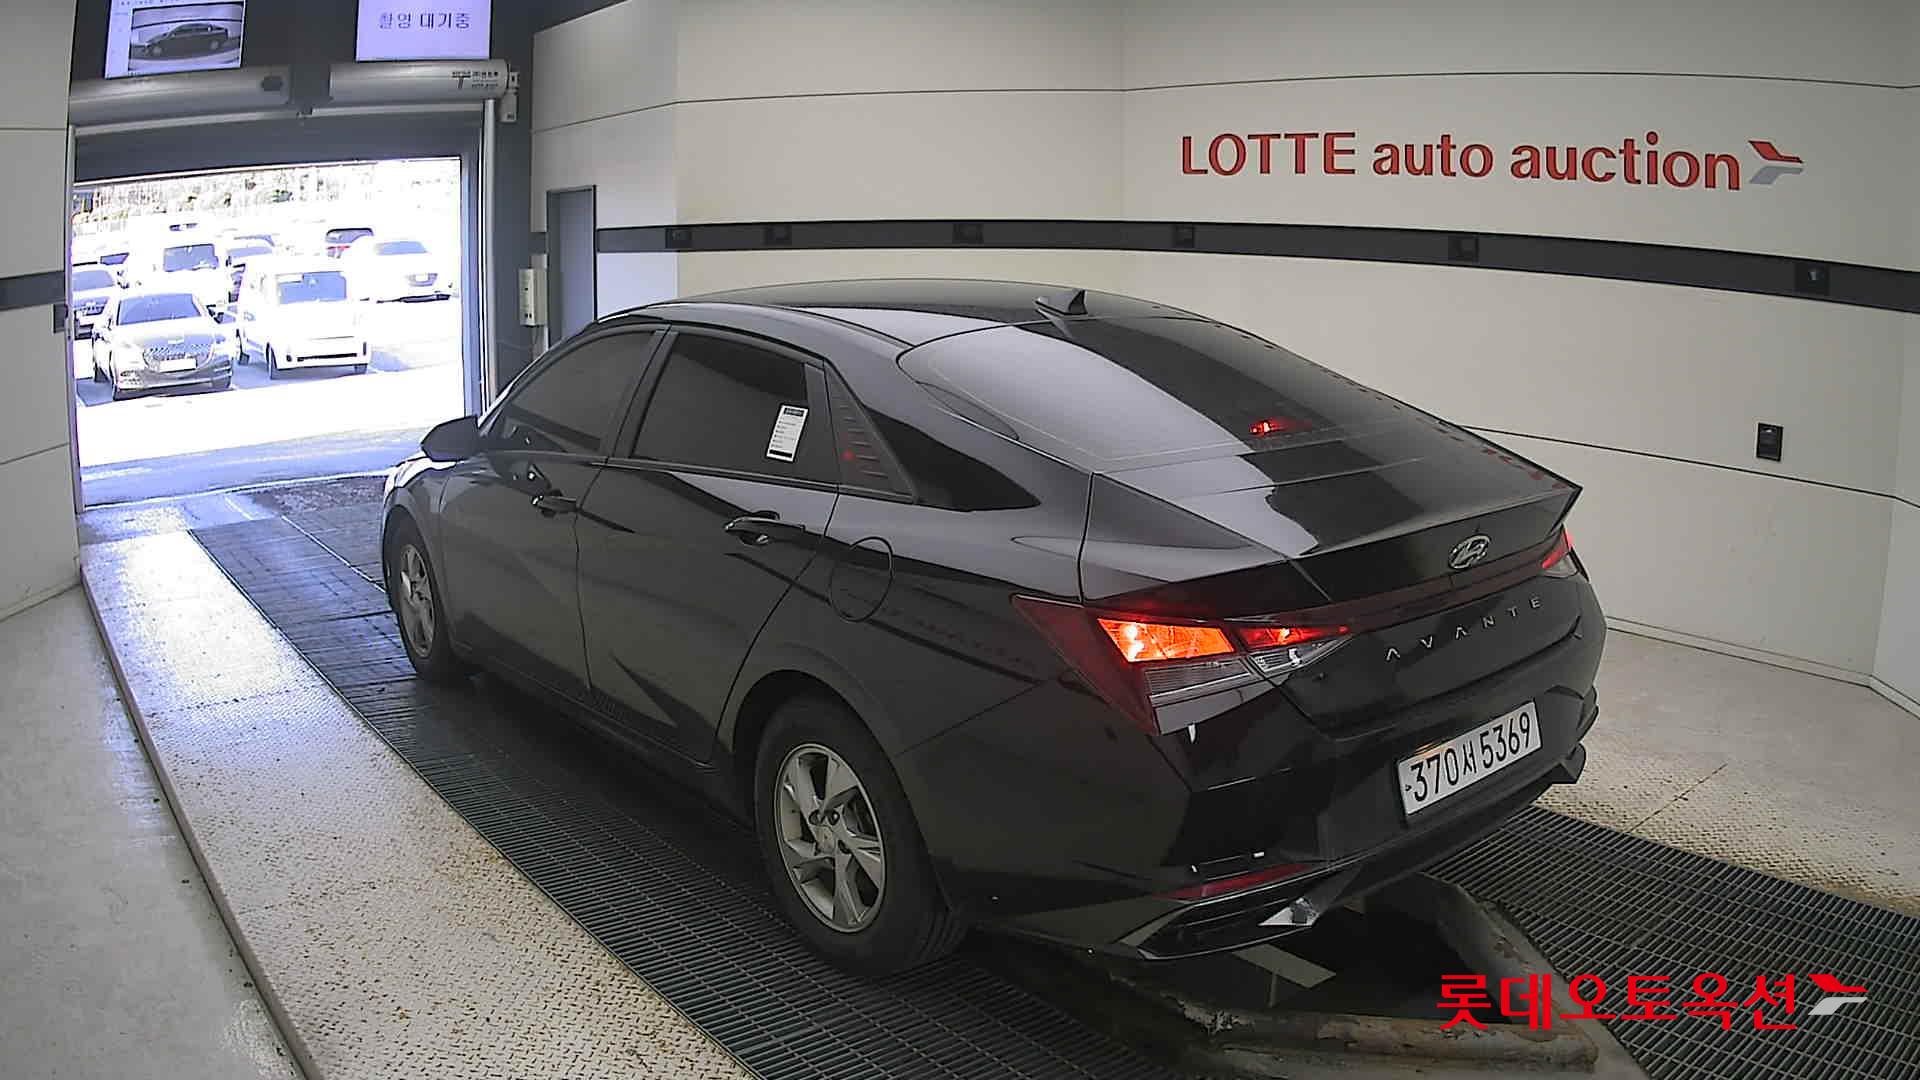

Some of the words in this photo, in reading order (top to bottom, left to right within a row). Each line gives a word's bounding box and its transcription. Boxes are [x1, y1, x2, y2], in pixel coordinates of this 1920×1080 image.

[419, 12, 470, 29] 대기중
[1182, 132, 1356, 176] LOTTE
[1372, 134, 1494, 177] auto
[1510, 131, 1740, 190] auction
[1385, 597, 1541, 661] AVANTE
